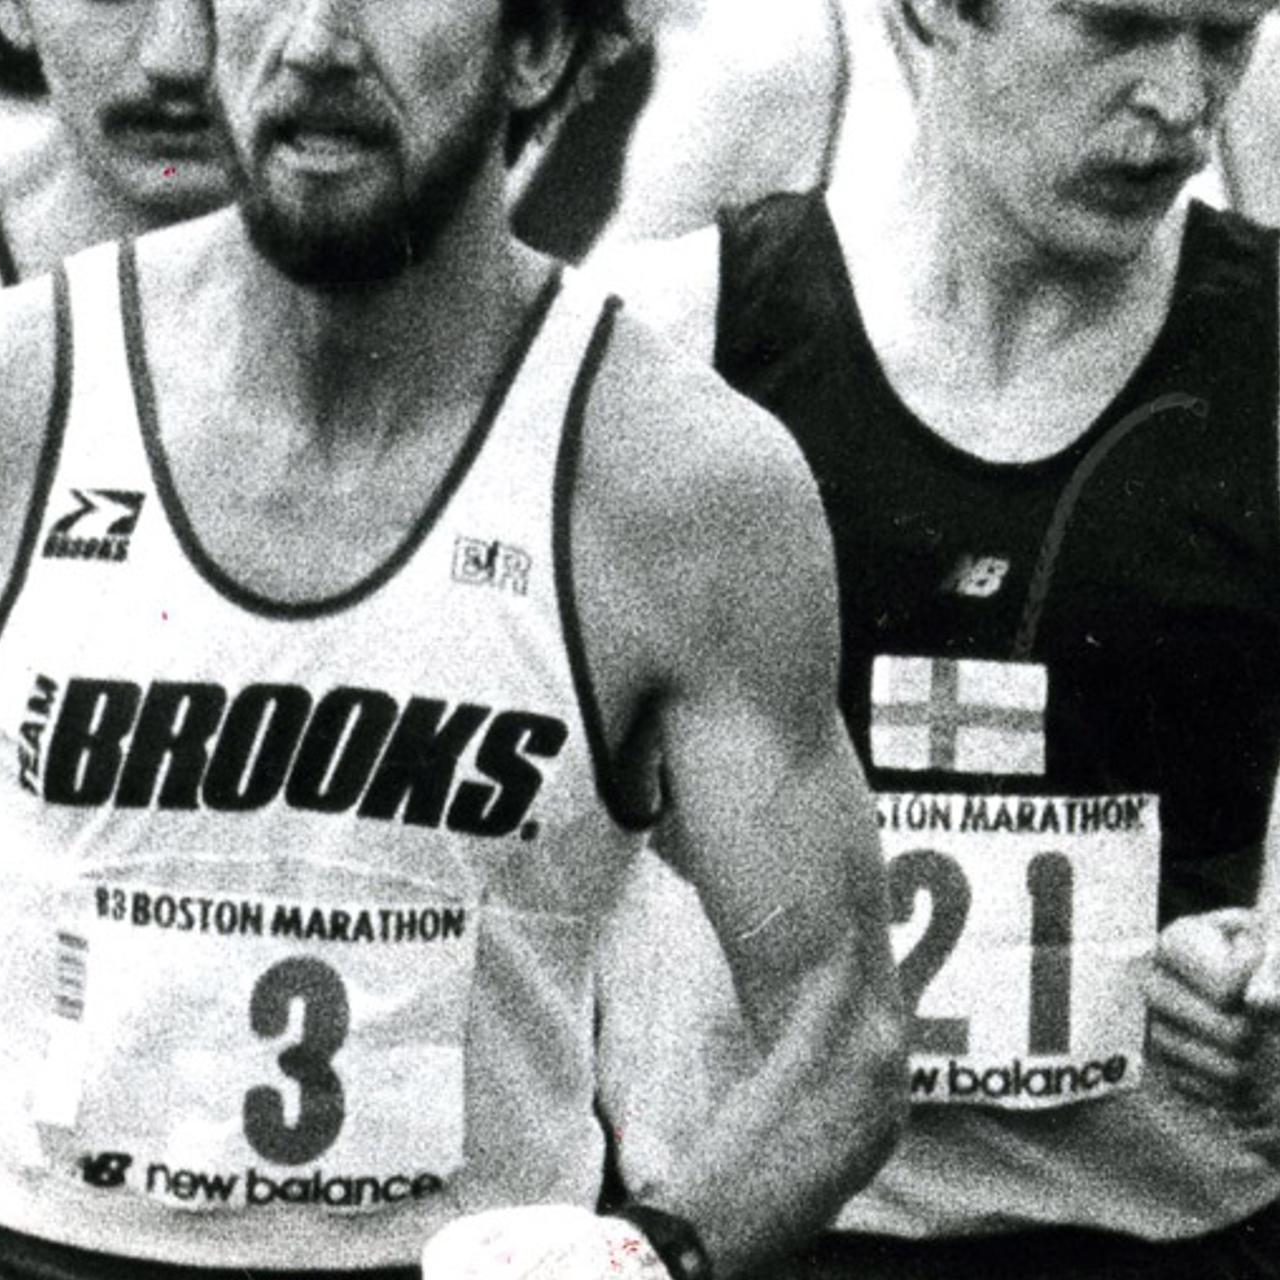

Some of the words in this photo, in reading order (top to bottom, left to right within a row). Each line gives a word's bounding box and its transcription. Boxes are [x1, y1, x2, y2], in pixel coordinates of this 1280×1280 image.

[18, 673, 59, 797] TEAM
[960, 795, 1147, 834] MARATHON
[131, 891, 264, 937] BOSTON
[270, 904, 466, 943] MARATHON
[888, 848, 1075, 1056] 21
[243, 955, 350, 1167] 3
[948, 1054, 1128, 1099] balance
[146, 1162, 238, 1201] new
[245, 1169, 443, 1206] balance
